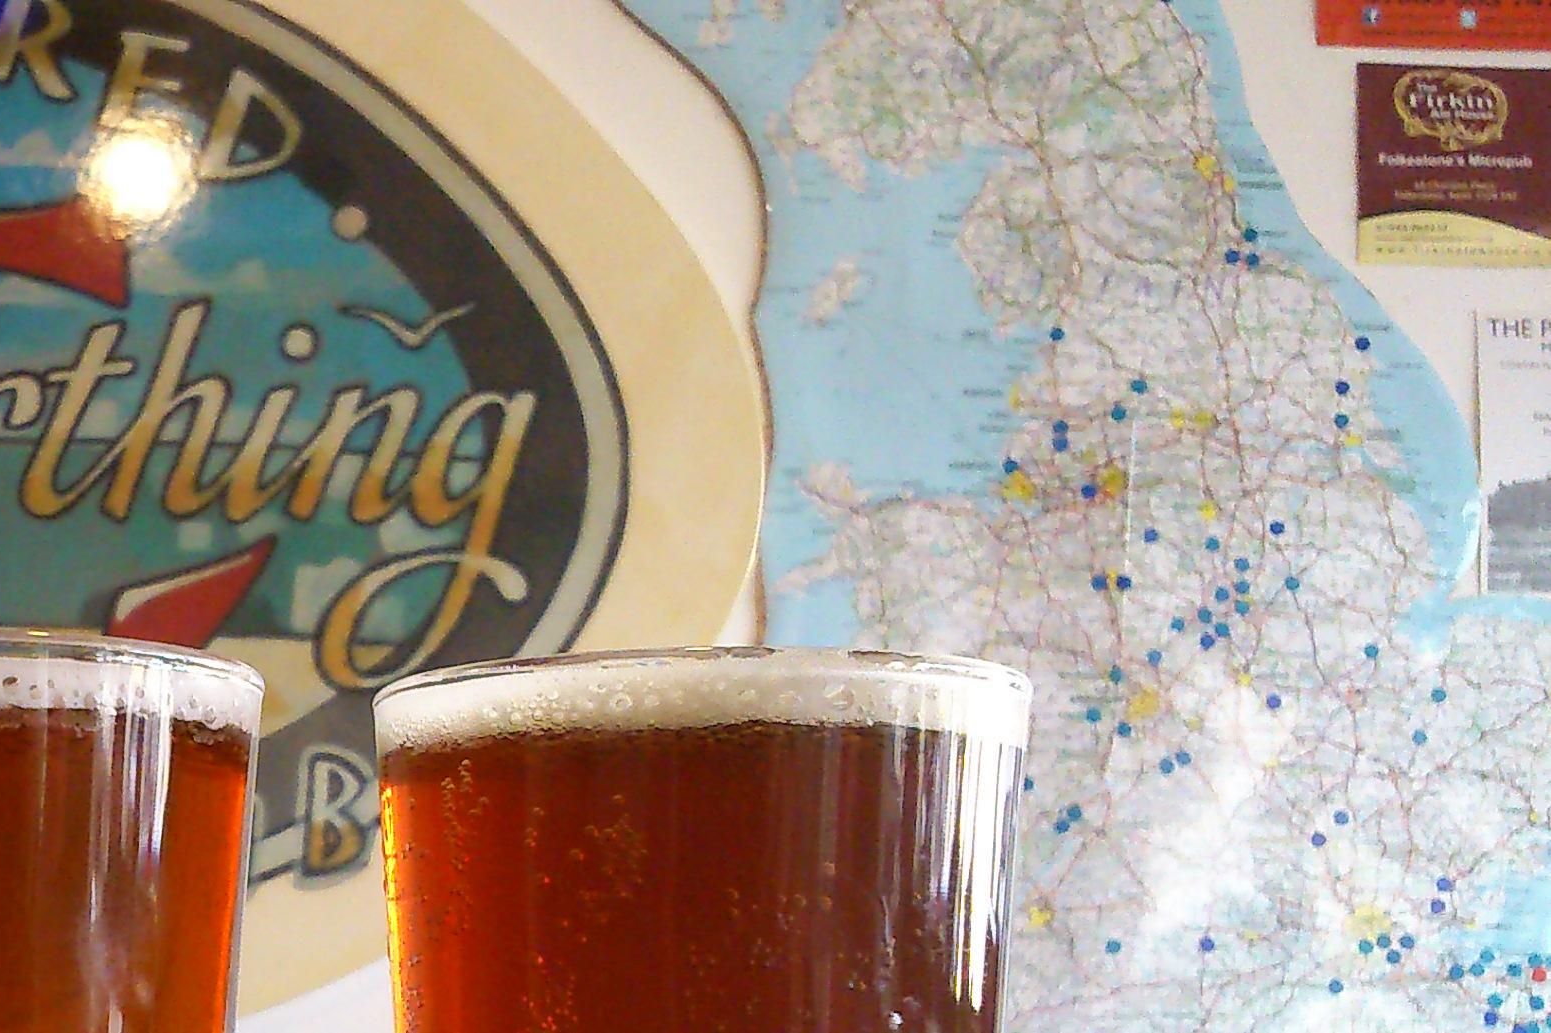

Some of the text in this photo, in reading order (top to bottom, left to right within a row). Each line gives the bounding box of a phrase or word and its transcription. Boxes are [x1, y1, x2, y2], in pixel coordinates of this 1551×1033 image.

[1408, 91, 1494, 110] Firkin
[1468, 153, 1534, 170] Micropub
[1489, 318, 1533, 338] THE
